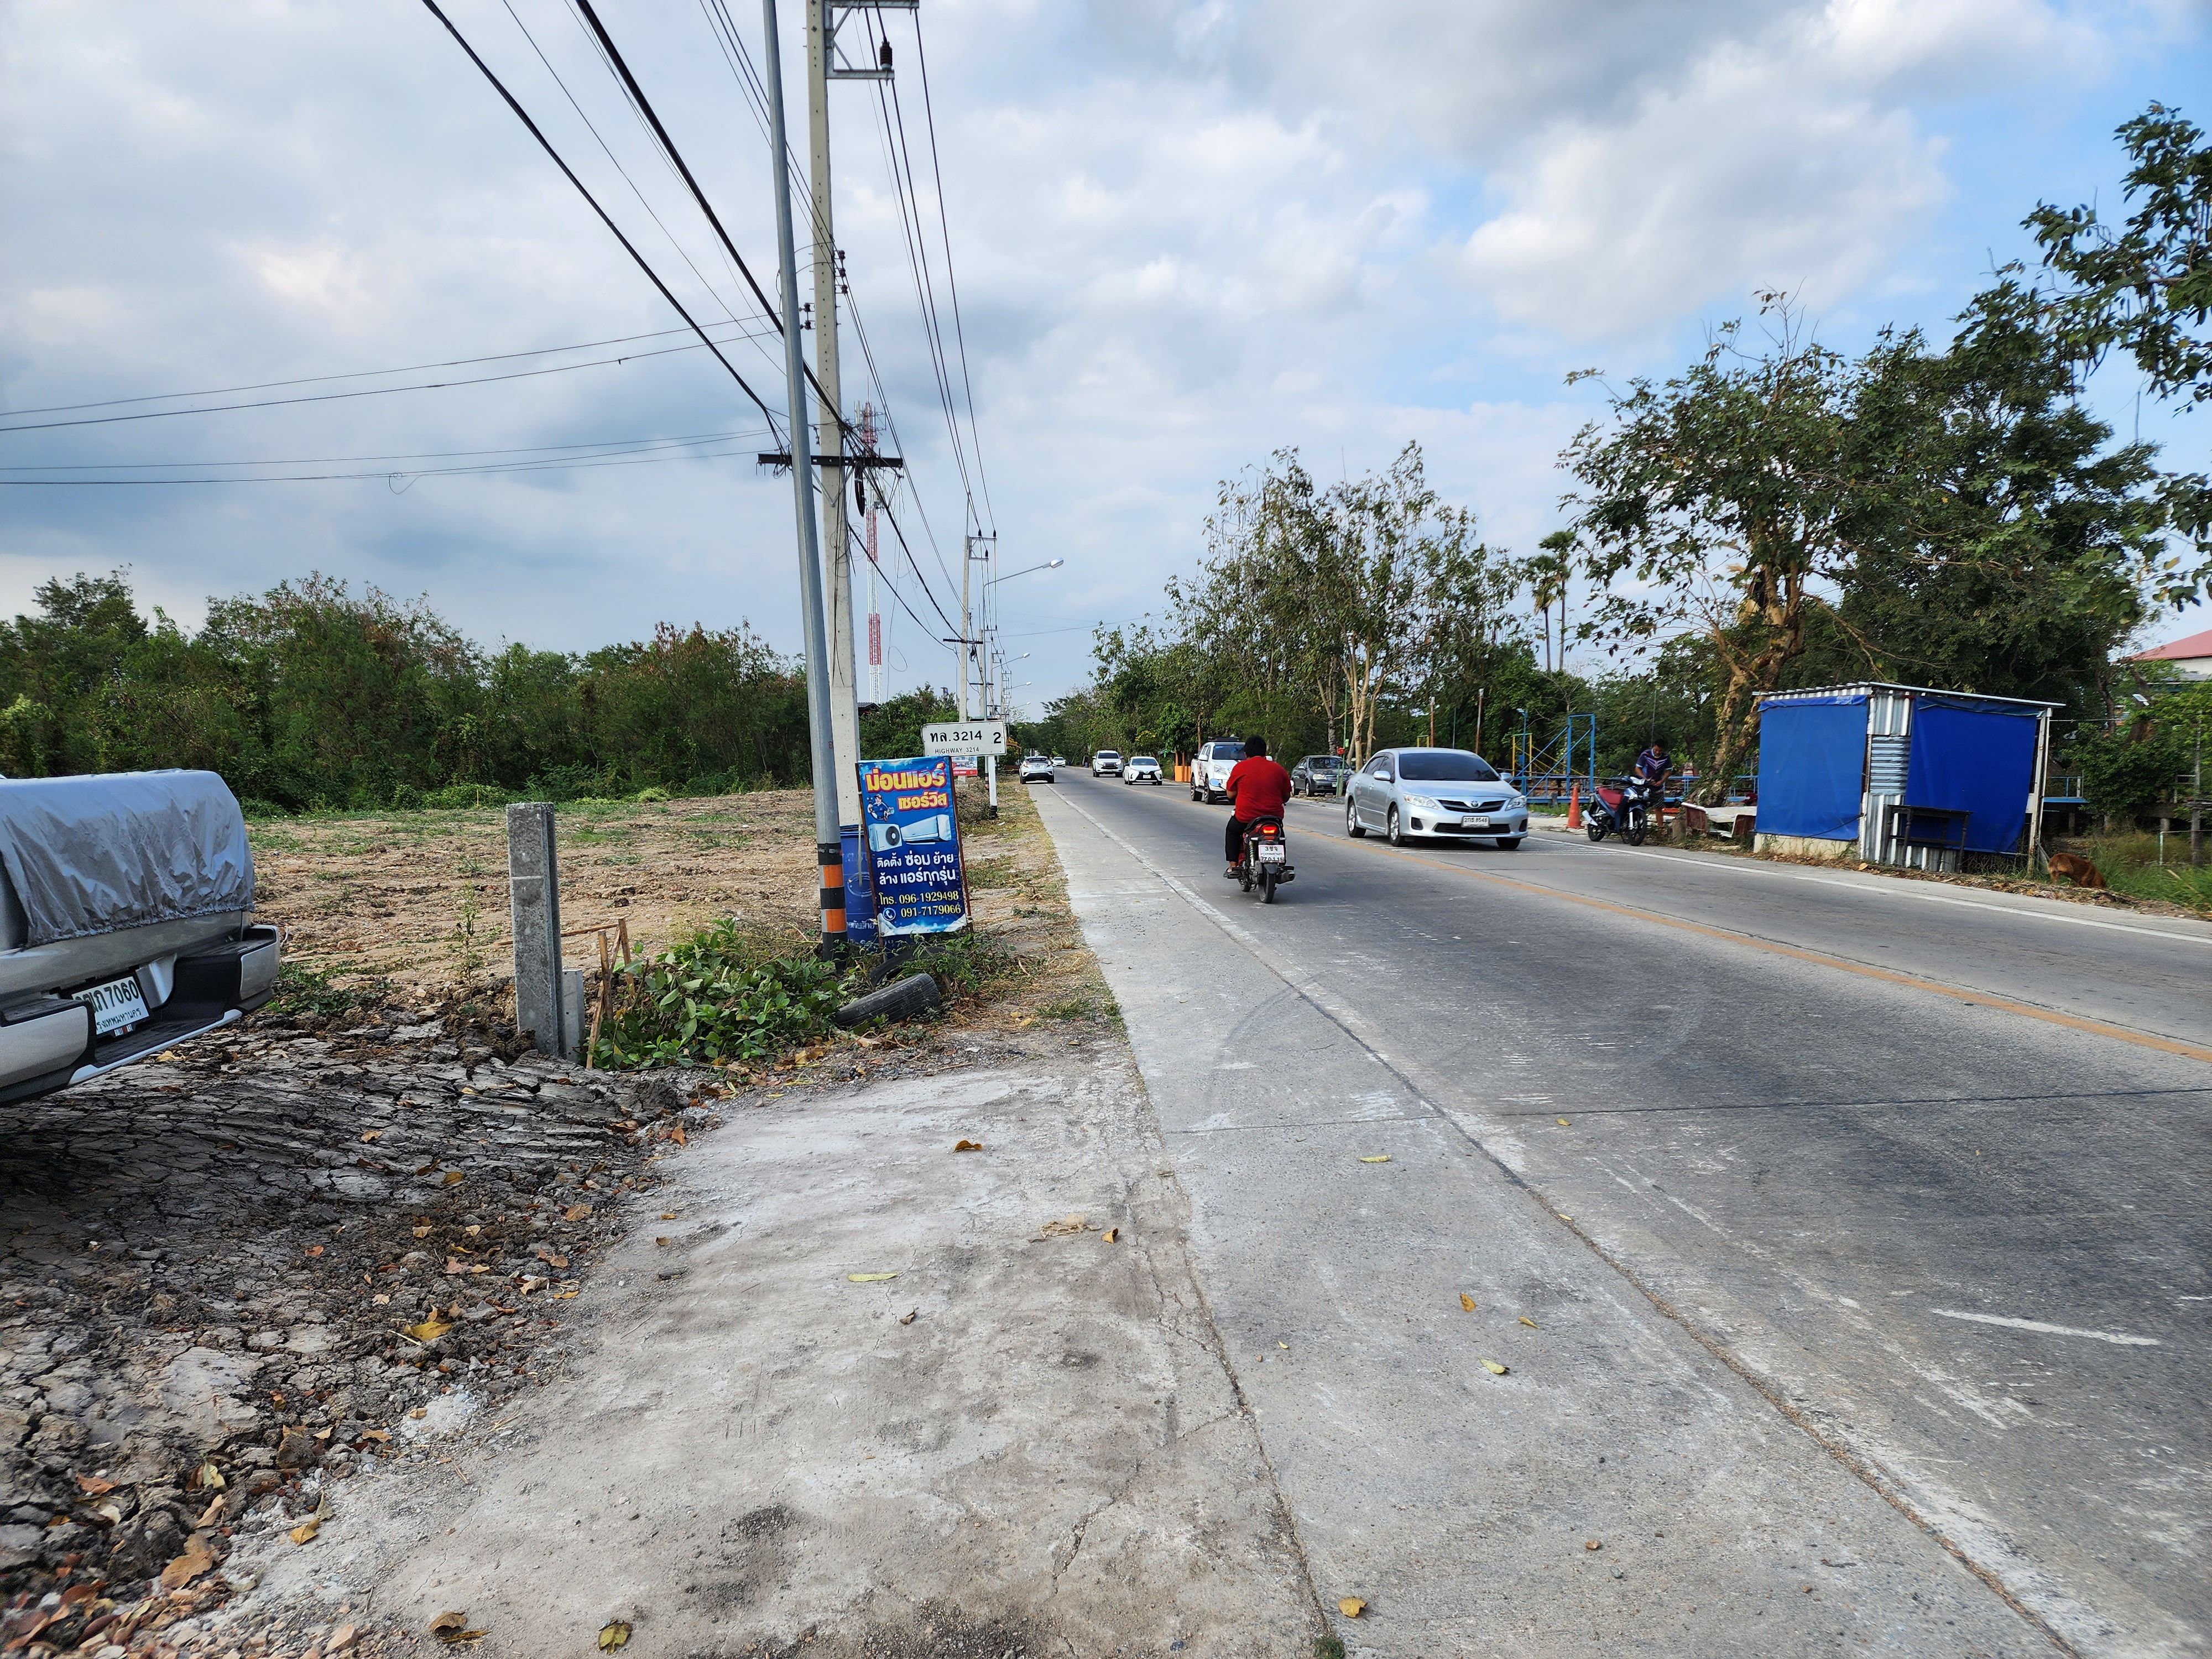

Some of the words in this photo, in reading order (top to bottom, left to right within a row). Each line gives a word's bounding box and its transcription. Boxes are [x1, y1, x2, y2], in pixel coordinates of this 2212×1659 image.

[930, 731, 982, 743] ทล.3214
[993, 732, 1001, 744] 2
[865, 763, 946, 791] ม่อนแอร์
[898, 791, 947, 810] เซอร์วิส
[877, 852, 902, 868] ติดตั้ง
[905, 851, 931, 866] ซ่อม
[933, 852, 954, 864] ย้าย
[879, 872, 898, 885] ล้าง
[900, 865, 956, 886] แอร์ทุกรุ่น
[879, 892, 897, 905] โทร.
[899, 890, 959, 905] 096-1929498
[900, 904, 962, 918] 091-7179066
[103, 980, 139, 1007] 7060
[96, 1008, 142, 1032] รุงเทพมหานคร
